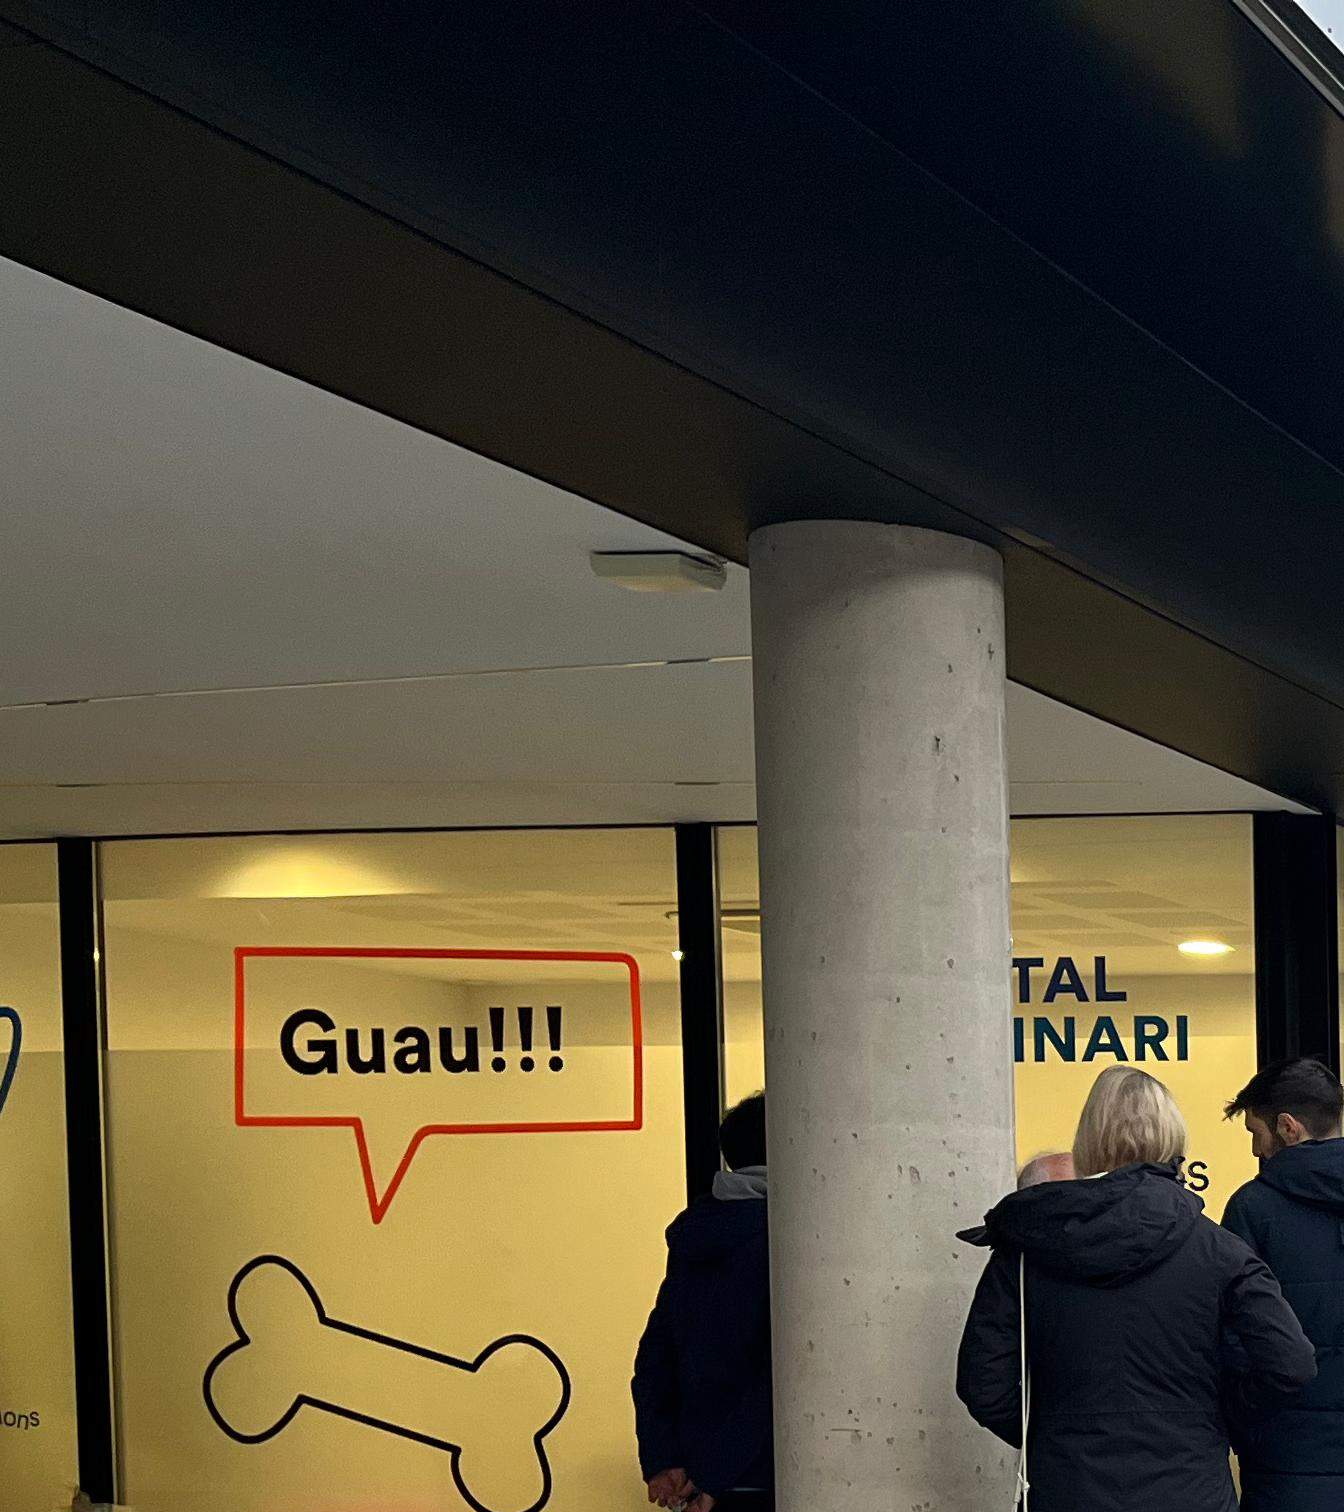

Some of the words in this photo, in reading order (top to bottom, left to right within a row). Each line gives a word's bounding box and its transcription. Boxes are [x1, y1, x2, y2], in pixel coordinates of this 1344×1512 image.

[1012, 955, 1128, 1004] TAL
[280, 1005, 563, 1075] Guau!!!
[1012, 1014, 1189, 1063] INARI
